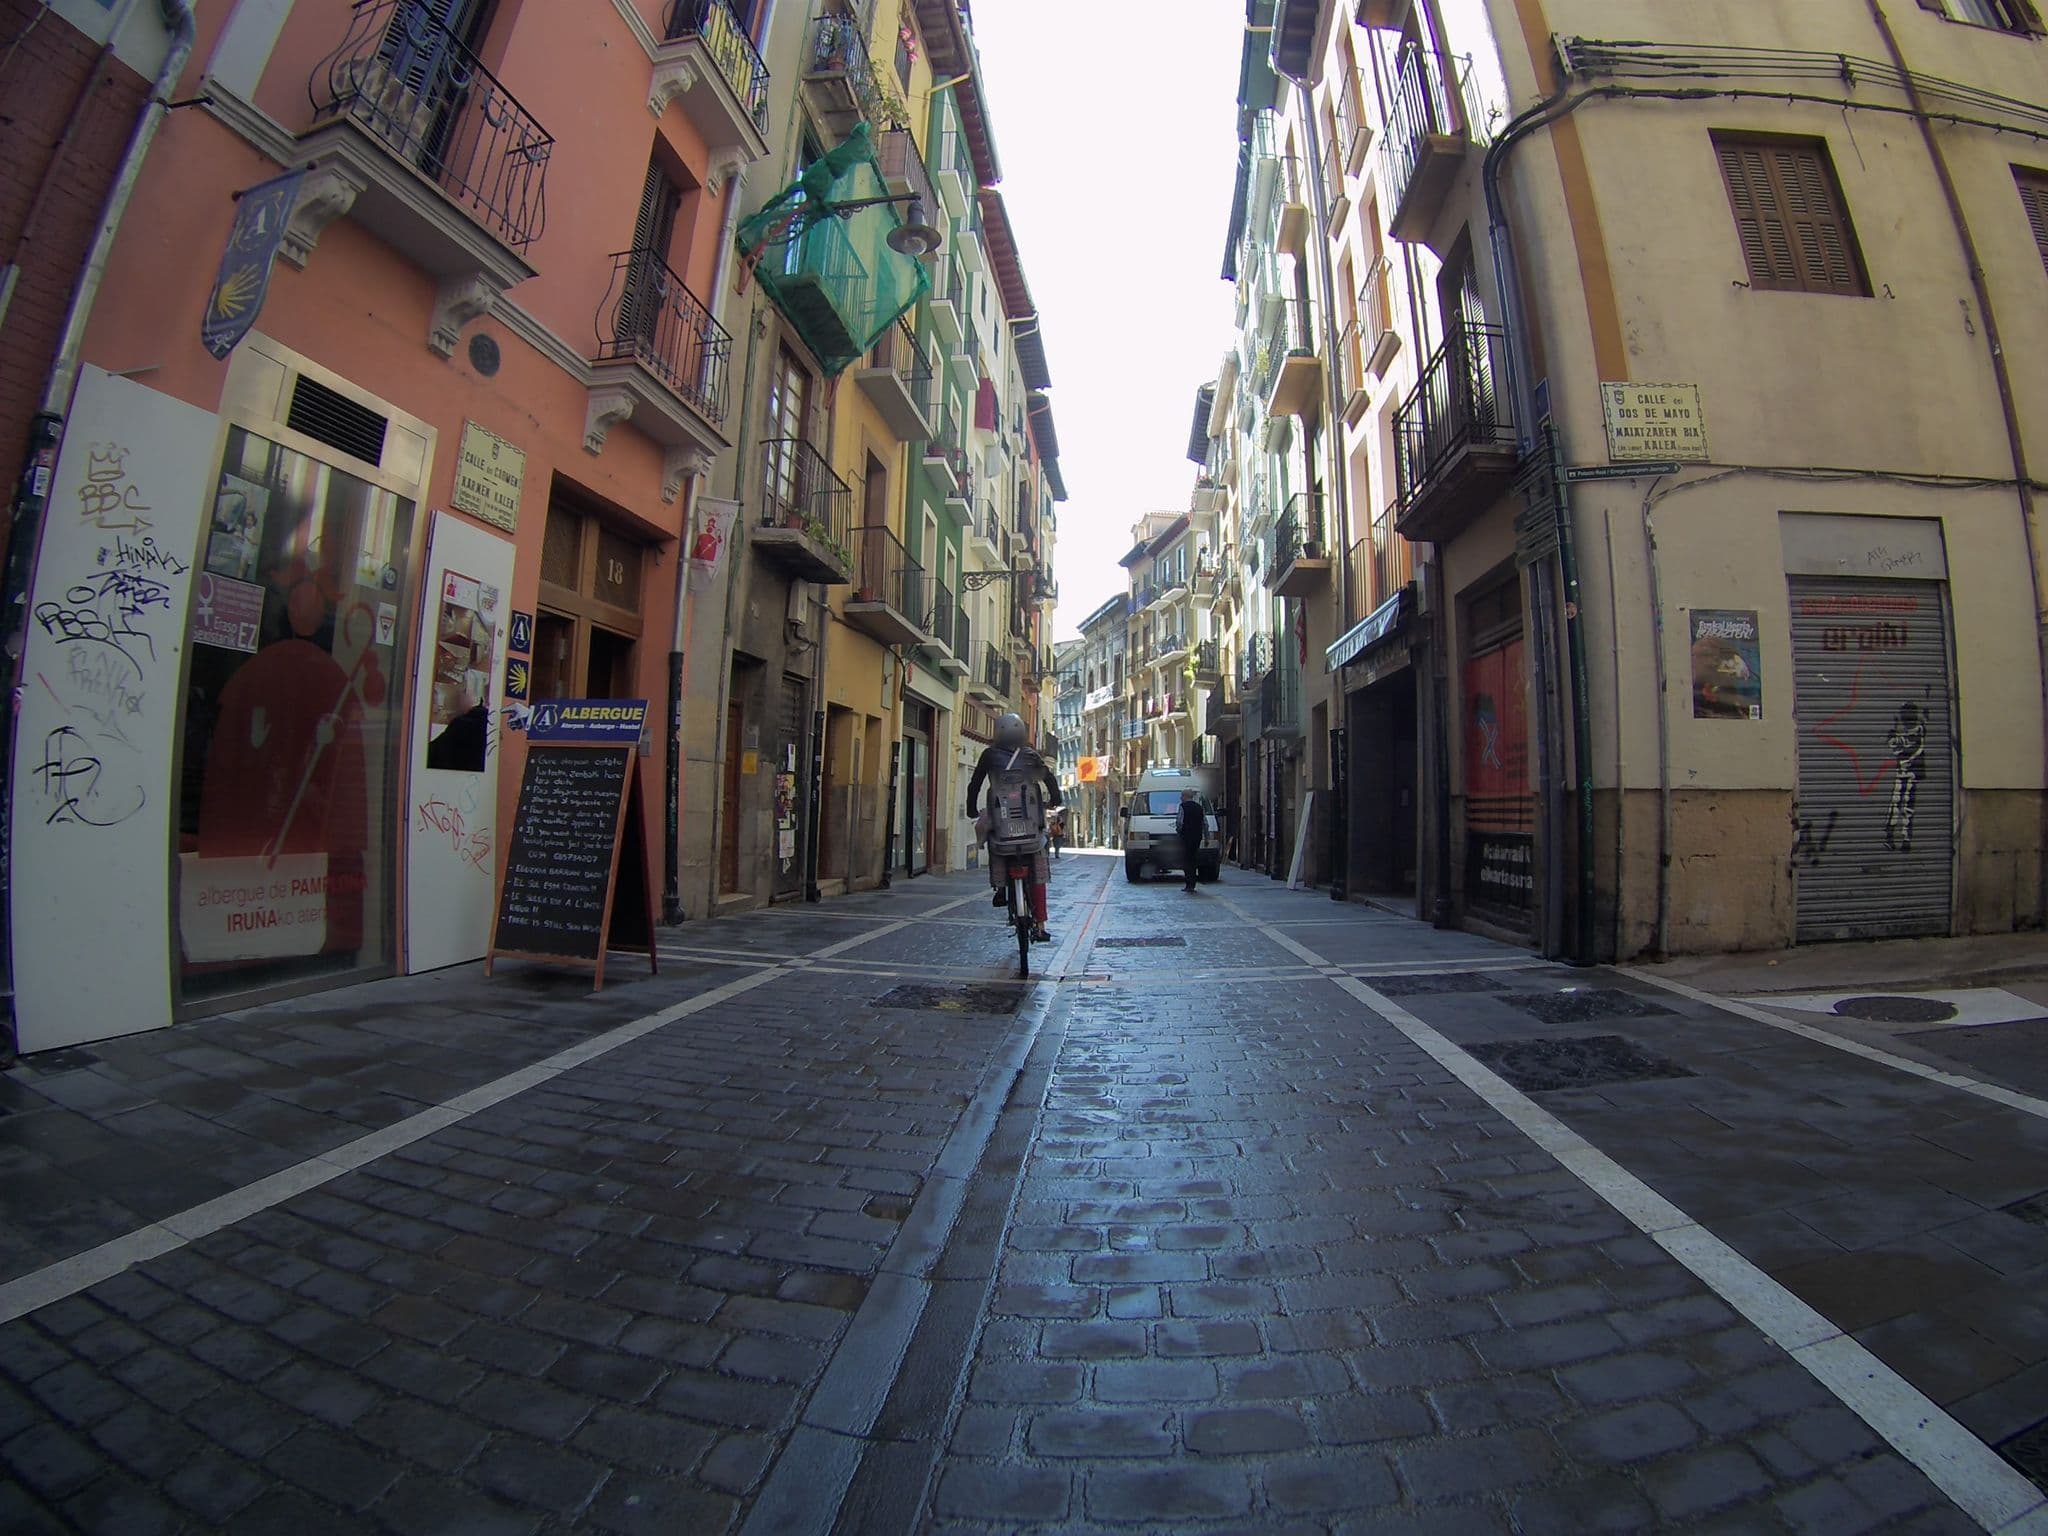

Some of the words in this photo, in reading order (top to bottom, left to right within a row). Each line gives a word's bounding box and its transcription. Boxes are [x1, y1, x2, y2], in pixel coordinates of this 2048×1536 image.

[1638, 394, 1666, 404] CALLE
[1619, 408, 1639, 418] DOS
[1645, 408, 1658, 418] DE
[1664, 408, 1690, 418] MAYO
[1616, 427, 1678, 437] MAIATZAREN
[1644, 440, 1677, 450] KALEA
[465, 451, 486, 470] CALLE
[494, 467, 518, 487] CARMEN
[462, 476, 490, 497] KARMEN
[494, 491, 514, 510] KALEA
[607, 558, 624, 585] 18
[238, 621, 257, 650] EZ
[515, 622, 525, 641] A
[538, 710, 550, 726] A
[560, 707, 644, 720] ALBERGUE
[199, 884, 265, 907] albergue
[269, 882, 287, 900] de
[227, 907, 294, 933] IRUÑAko
